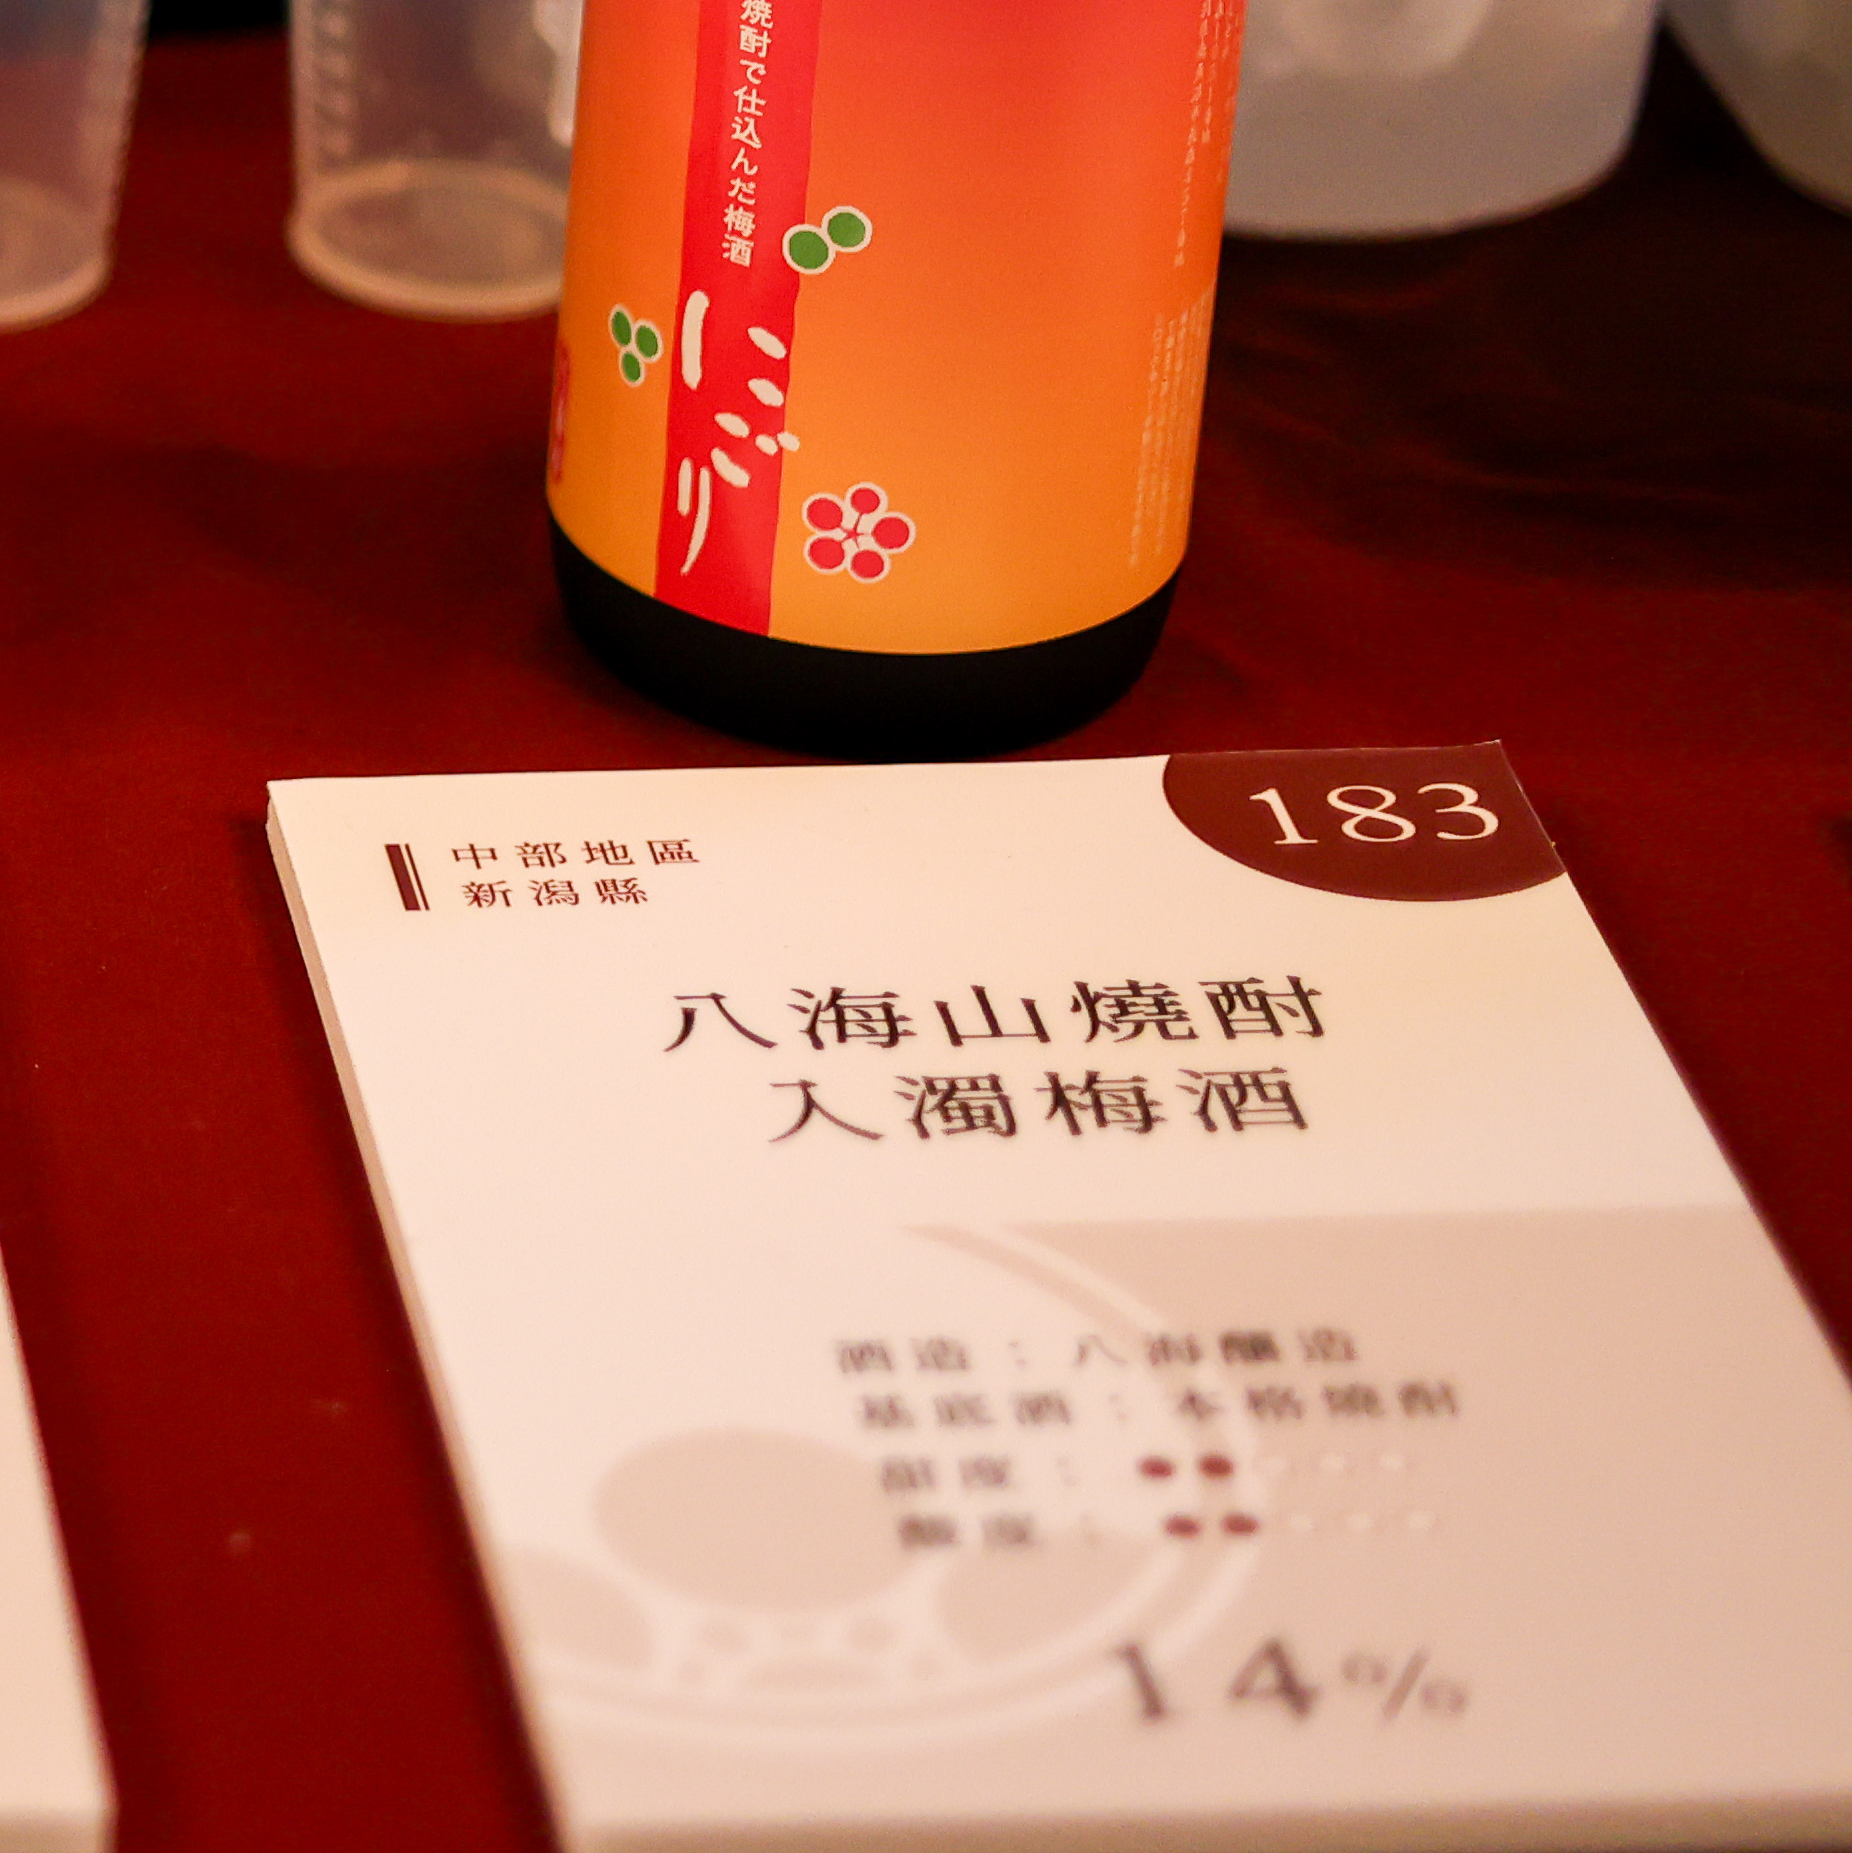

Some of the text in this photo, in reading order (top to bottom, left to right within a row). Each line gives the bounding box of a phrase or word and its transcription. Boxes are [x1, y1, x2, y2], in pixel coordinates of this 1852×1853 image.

[677, 291, 800, 575] にごり
[1248, 782, 1501, 845] 183
[451, 839, 701, 870] 中部地區
[662, 975, 1325, 1048] 八海山燒酎
[768, 1066, 1309, 1143] 入濁梅酒
[1112, 1637, 1469, 1721] 14%
